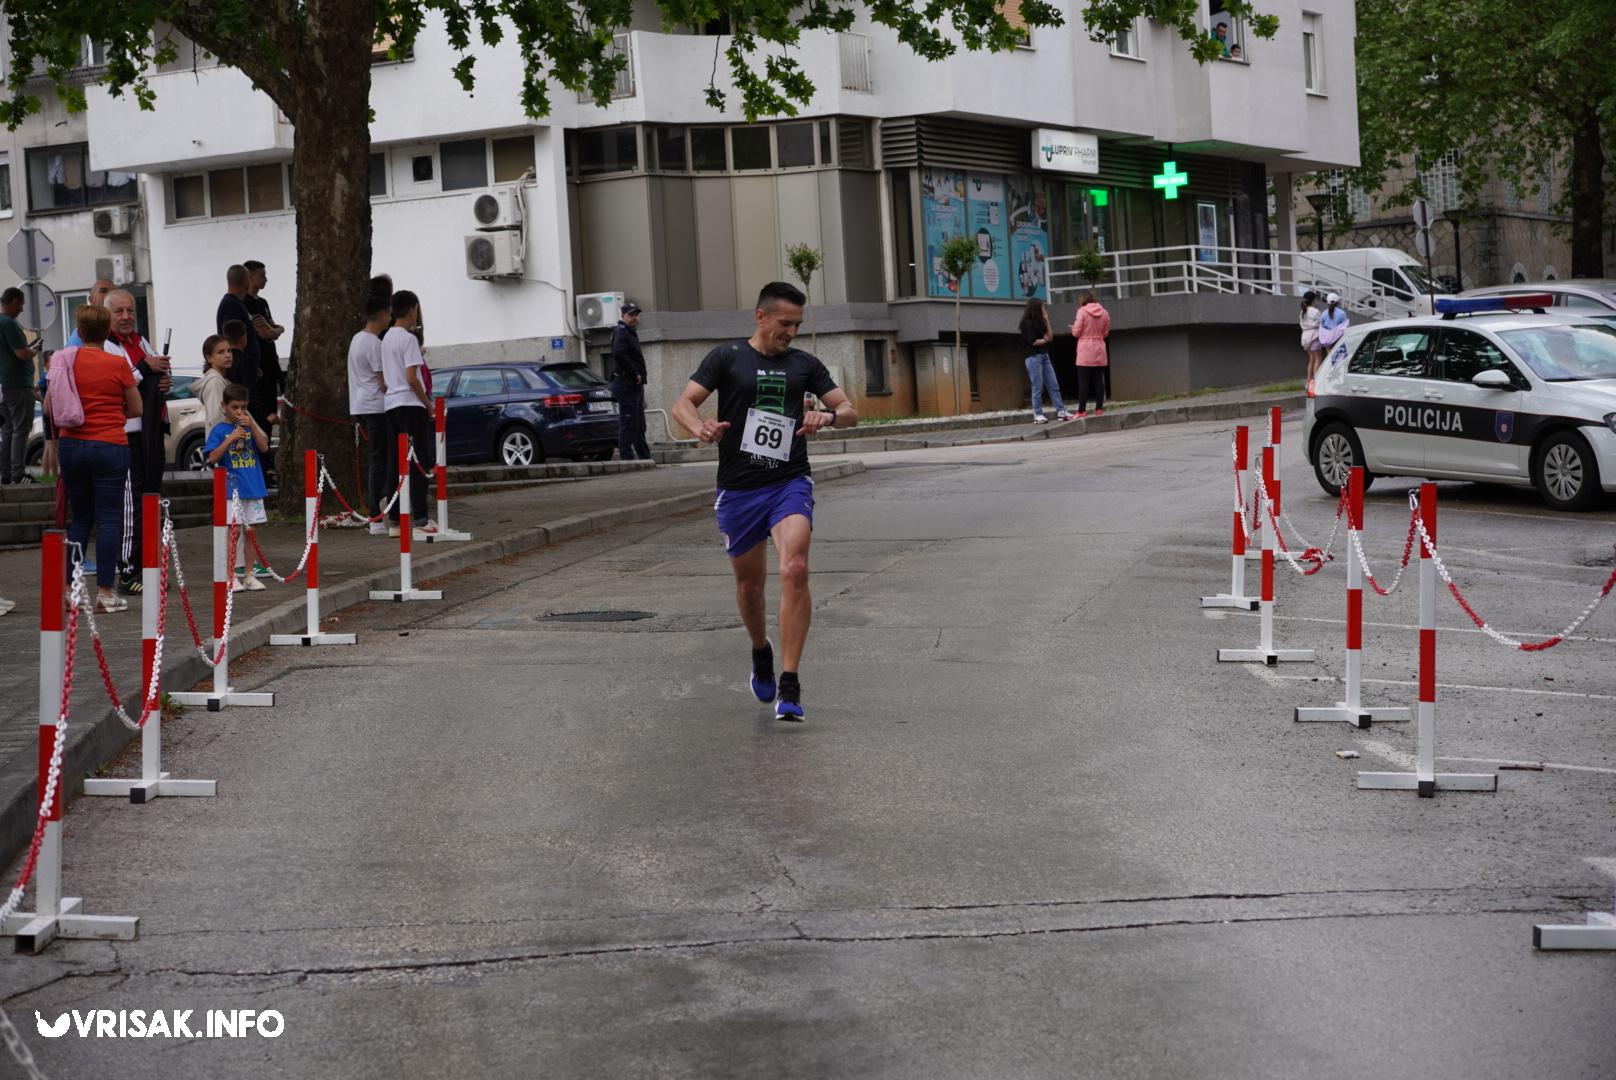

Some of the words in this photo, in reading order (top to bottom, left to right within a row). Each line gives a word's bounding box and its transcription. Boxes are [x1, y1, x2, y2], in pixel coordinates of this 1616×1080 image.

[1051, 145, 1073, 156] LUPRIV
[1384, 404, 1463, 433] POLICIJA
[754, 425, 782, 449] 69
